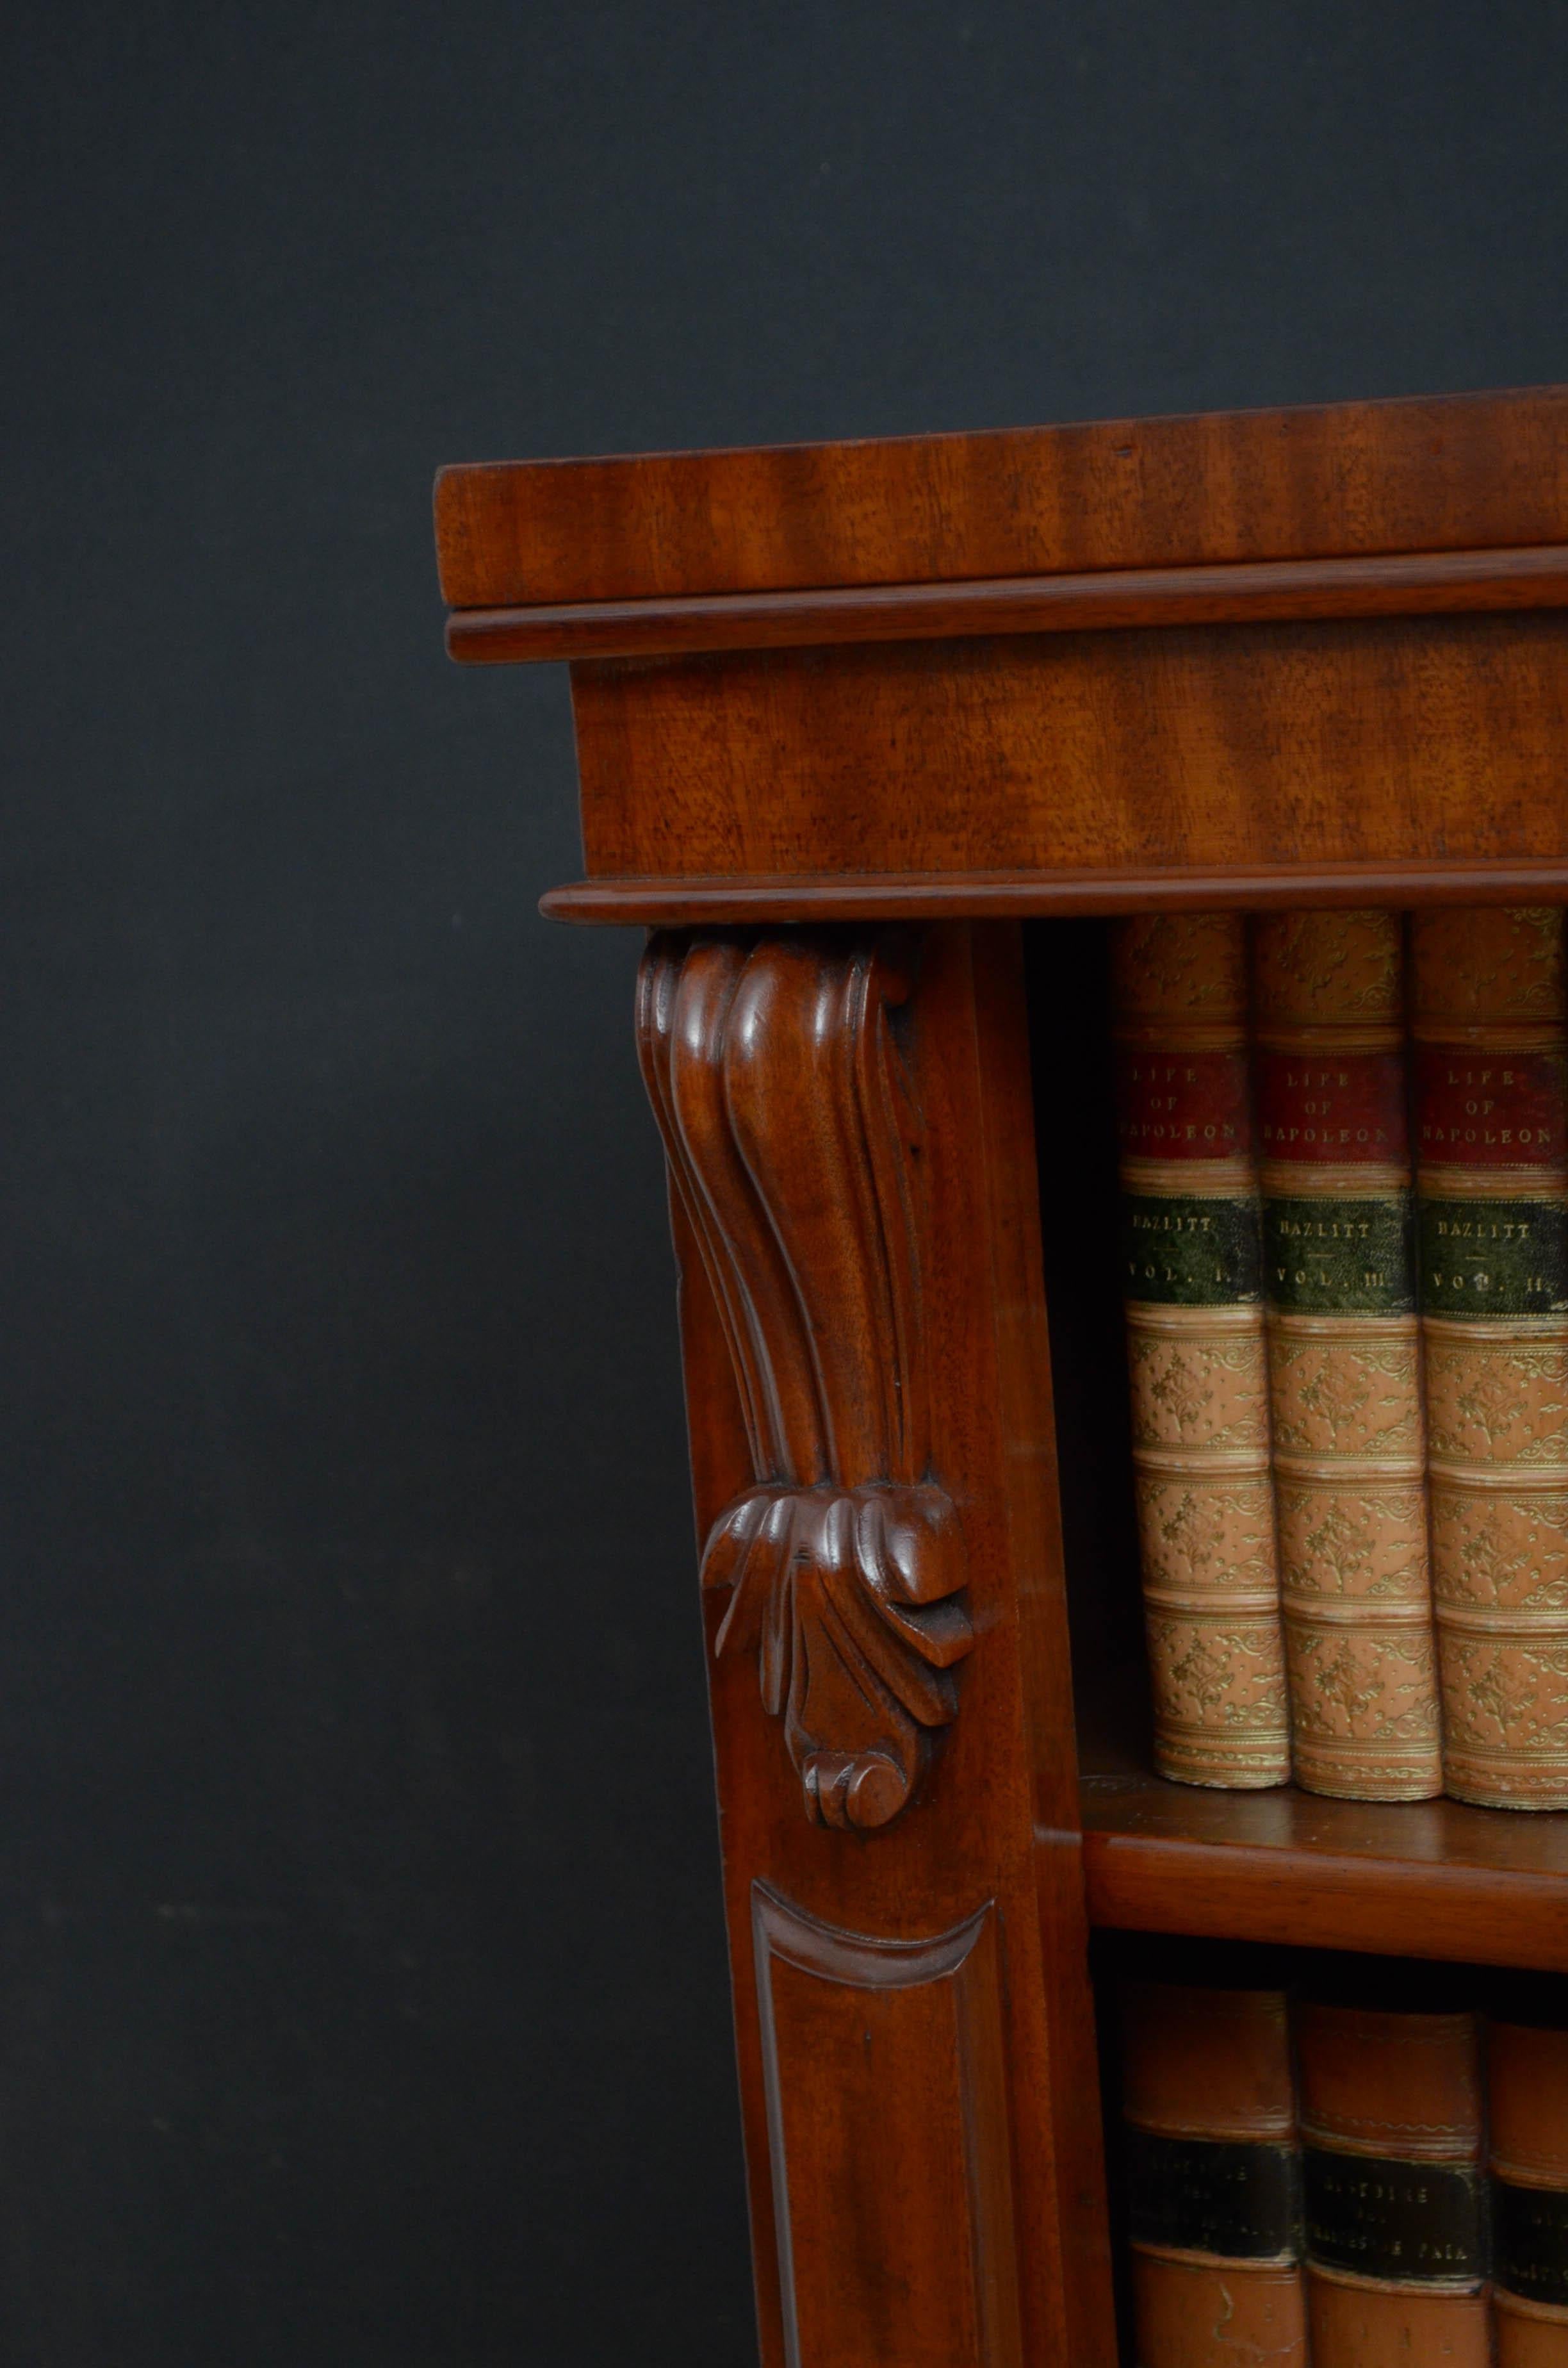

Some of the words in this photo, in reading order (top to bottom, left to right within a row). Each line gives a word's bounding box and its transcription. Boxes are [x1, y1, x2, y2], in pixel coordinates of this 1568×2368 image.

[1132, 1066, 1198, 1082] LIFE
[1286, 1072, 1349, 1087] LIFE
[1447, 1070, 1515, 1086] LIFE
[1149, 1096, 1179, 1112] OF
[1304, 1101, 1333, 1115] OF
[1465, 1100, 1495, 1115] OF
[1263, 1124, 1388, 1142] NAPOLEON
[1423, 1125, 1551, 1144] NAPOLEON
[1280, 1219, 1369, 1238] HAZLITT
[1437, 1220, 1530, 1239] HAZLITT
